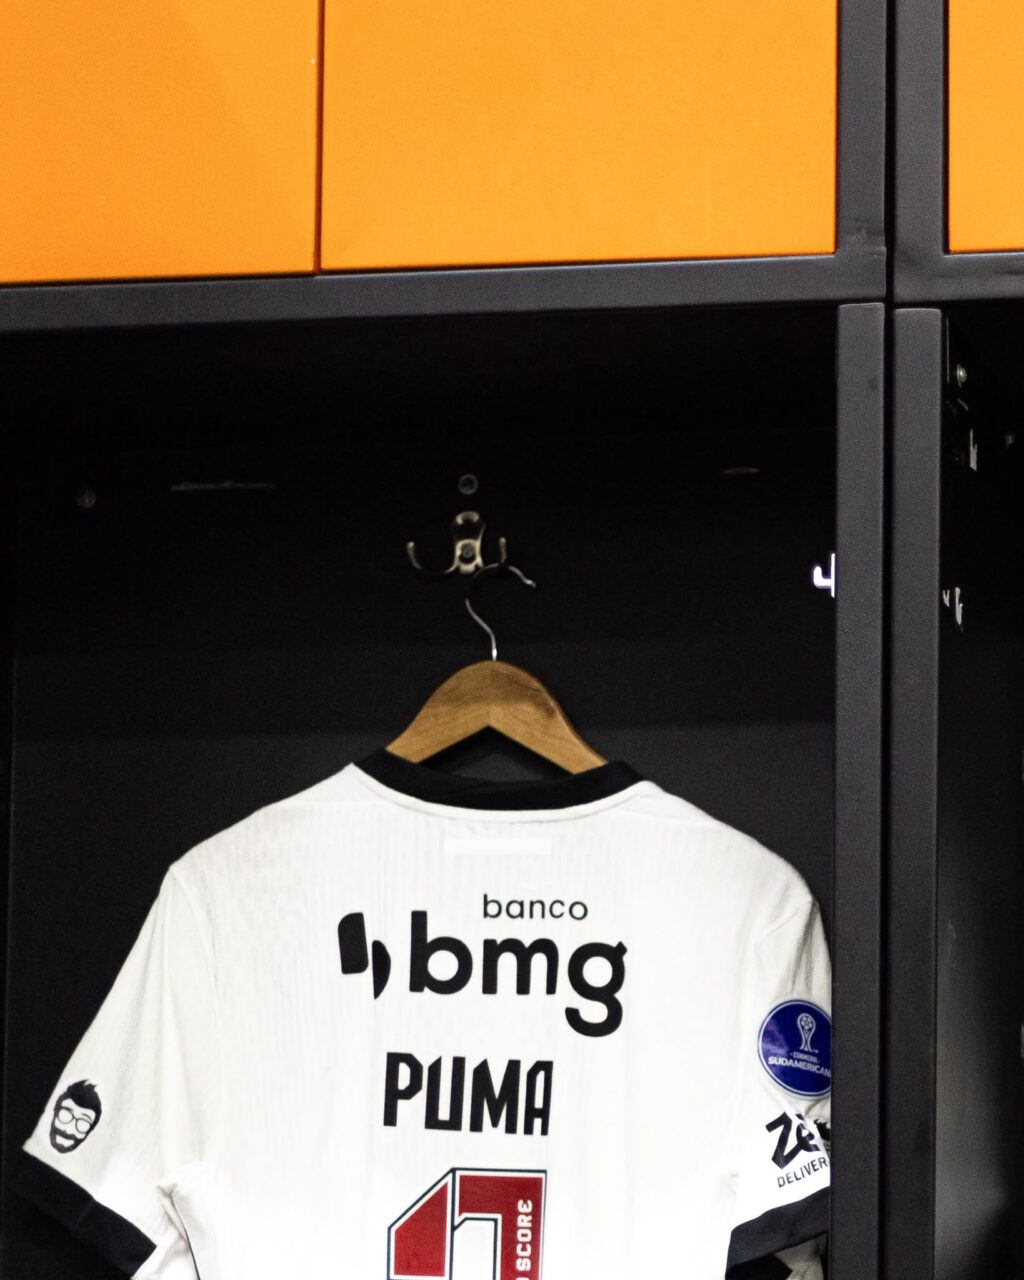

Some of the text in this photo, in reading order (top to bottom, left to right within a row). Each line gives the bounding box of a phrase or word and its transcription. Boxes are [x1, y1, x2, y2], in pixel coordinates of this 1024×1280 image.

[483, 893, 588, 920] banco
[409, 910, 627, 1037] bmg
[383, 1052, 553, 1136] PUMA
[516, 1199, 533, 1271] SCORE
